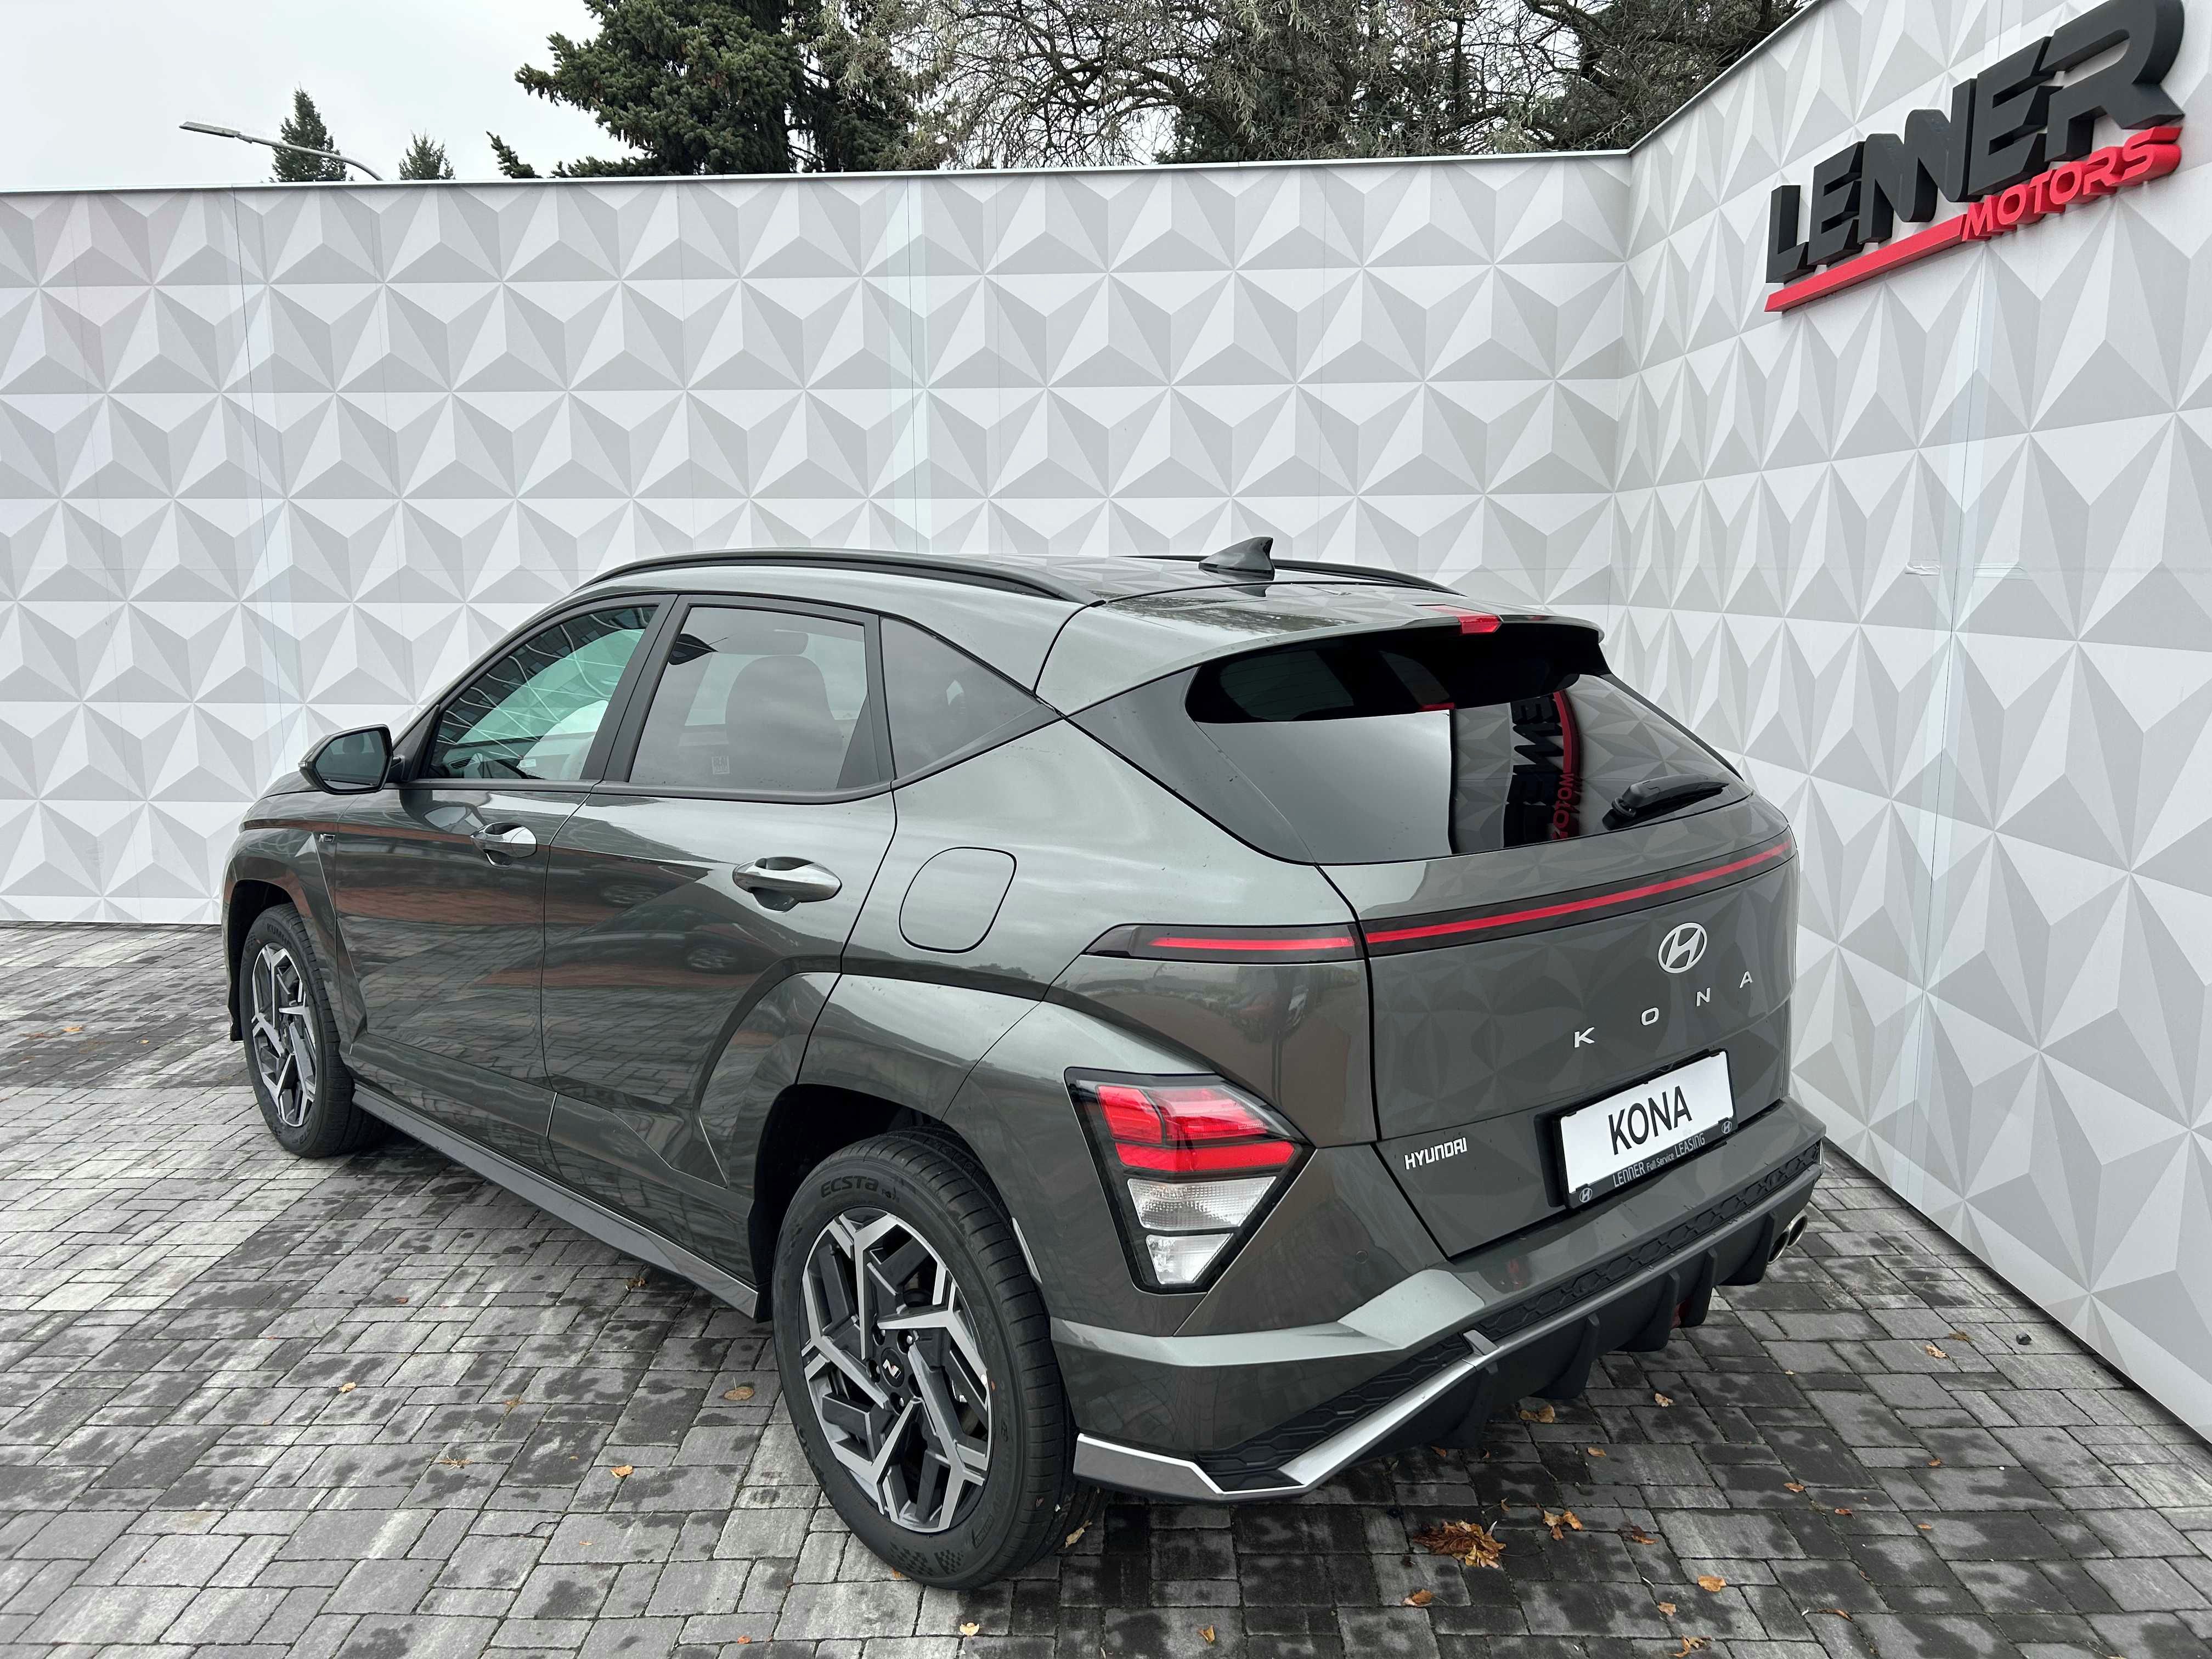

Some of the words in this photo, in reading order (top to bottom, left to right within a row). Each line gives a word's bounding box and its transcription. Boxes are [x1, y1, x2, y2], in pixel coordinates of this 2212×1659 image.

[1766, 0, 2186, 283] LENNER
[1962, 127, 2182, 242] MOTORS
[1574, 971, 1753, 1048] KONA
[1404, 1137, 1468, 1170] HYUNDAI
[1608, 1085, 1692, 1155] KONA
[1612, 1161, 1646, 1188] LENNER
[1646, 1161, 1656, 1172] Full
[1656, 1153, 1674, 1167] Service
[1674, 1132, 1706, 1158] LEASING
